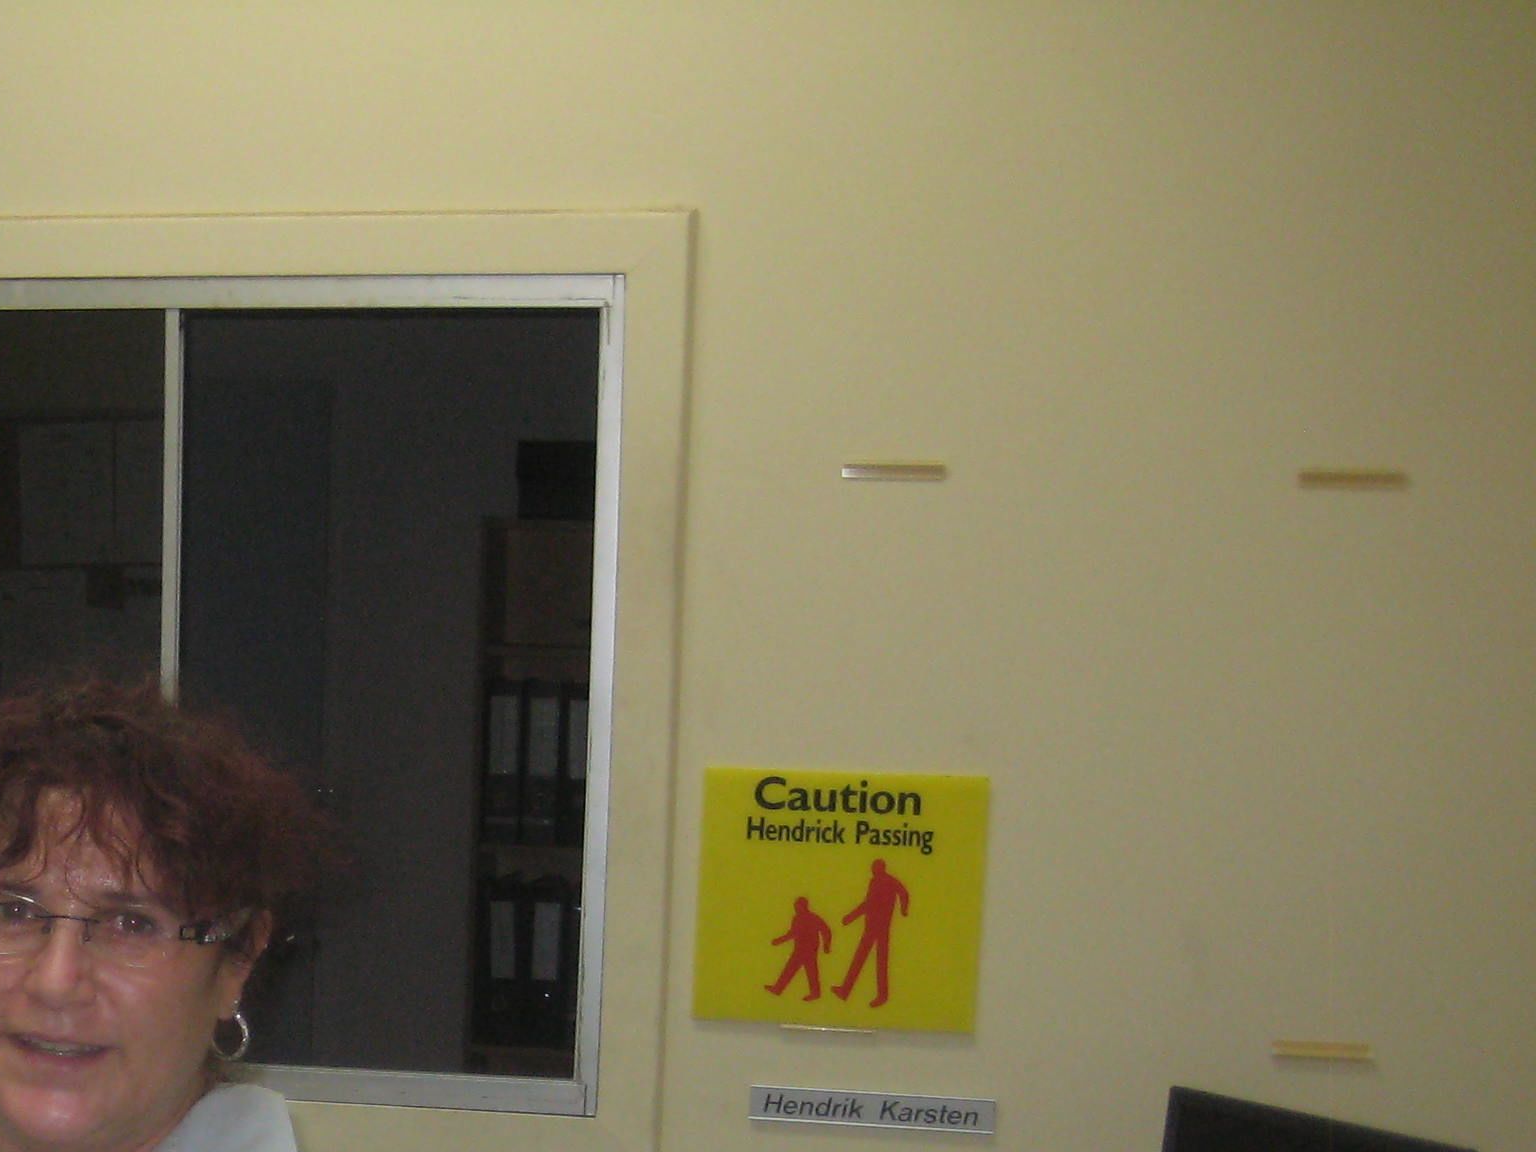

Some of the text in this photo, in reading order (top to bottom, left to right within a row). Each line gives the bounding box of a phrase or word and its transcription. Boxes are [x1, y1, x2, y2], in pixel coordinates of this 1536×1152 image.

[754, 776, 922, 816] Caution
[746, 816, 934, 855] Hendrick Passing
[763, 1093, 979, 1127] Hendrik Karsten
